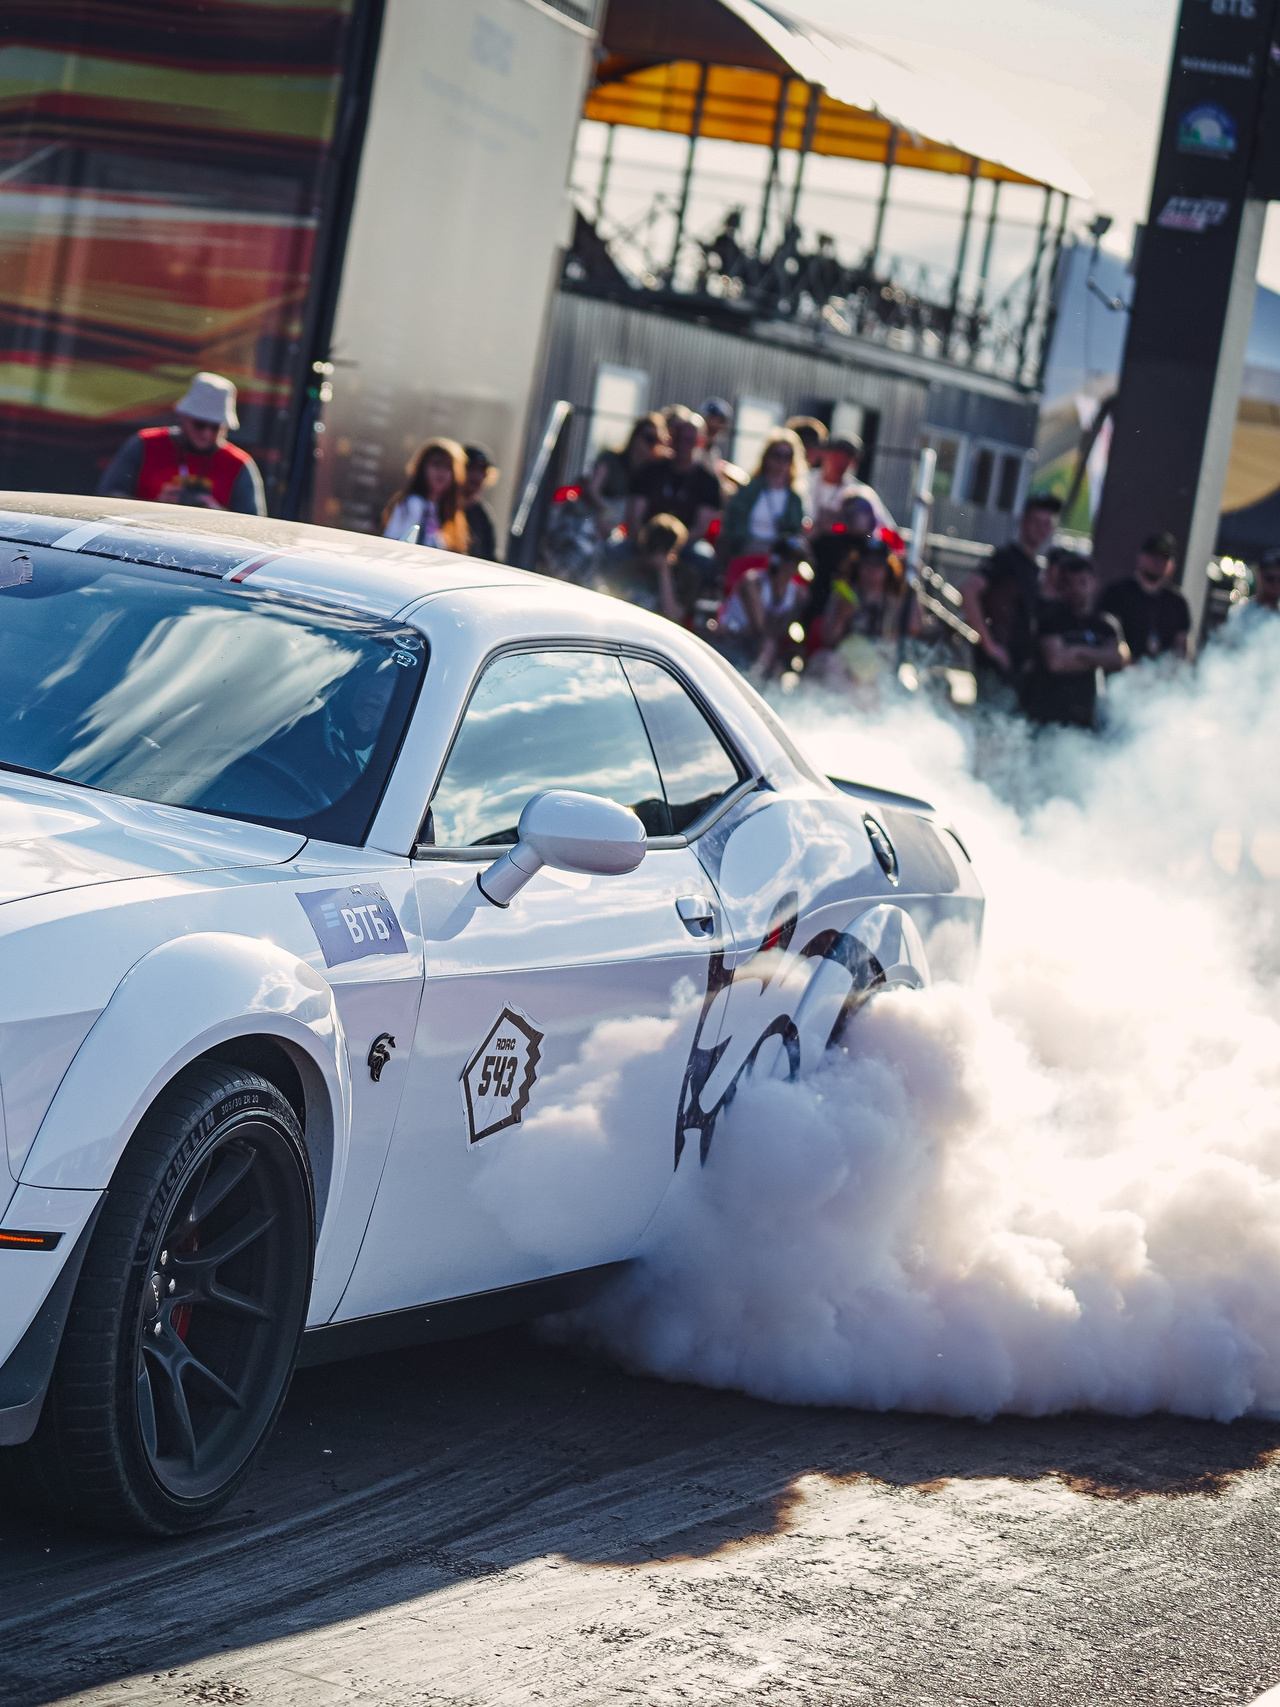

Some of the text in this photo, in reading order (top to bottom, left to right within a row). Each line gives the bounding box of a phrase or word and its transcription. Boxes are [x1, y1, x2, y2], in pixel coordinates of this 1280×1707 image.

[340, 904, 391, 944] ВТБ
[495, 1037, 517, 1051] RDRC
[477, 1055, 518, 1097] 543
[150, 1110, 215, 1224] MICHELIN
[221, 1096, 242, 1116] 305/30
